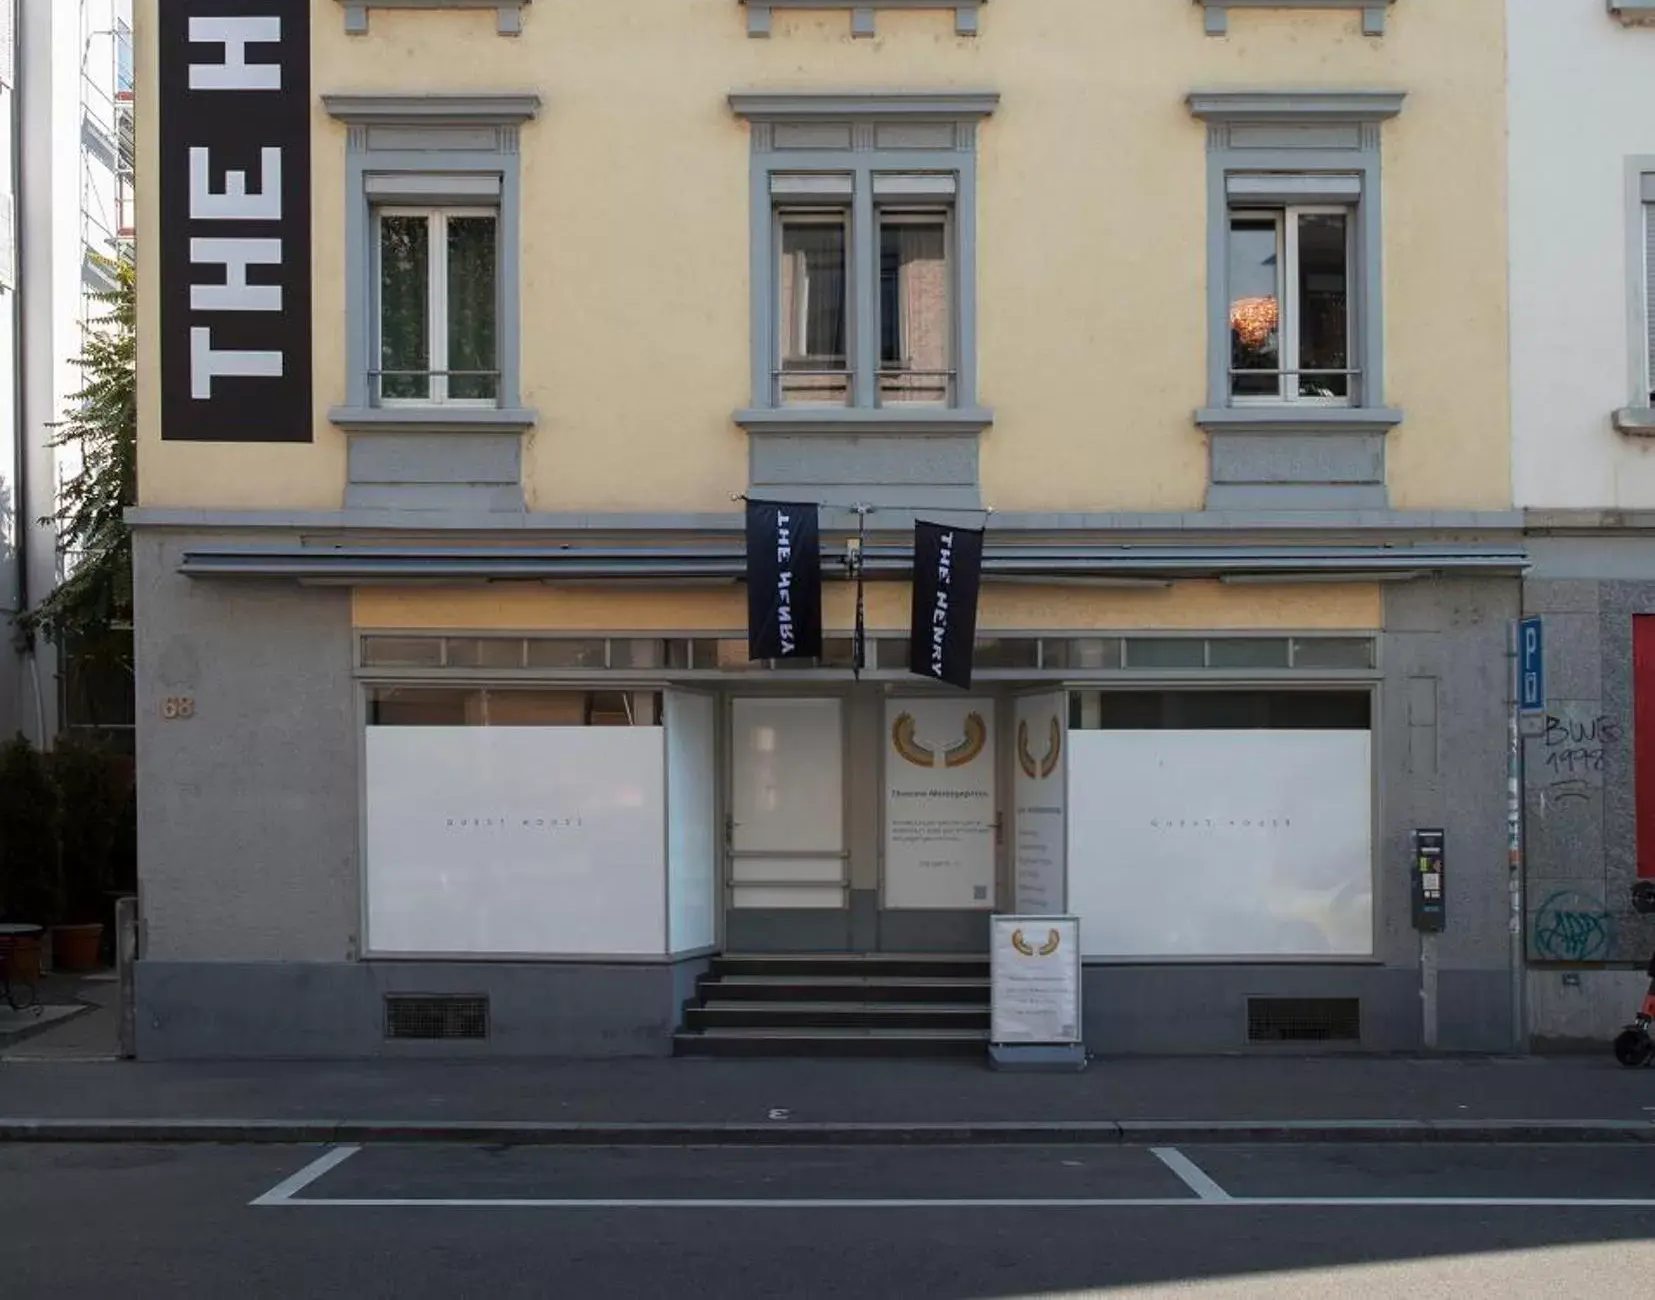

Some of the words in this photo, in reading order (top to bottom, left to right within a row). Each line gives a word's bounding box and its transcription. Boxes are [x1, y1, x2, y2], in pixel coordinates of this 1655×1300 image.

[189, 146, 283, 399] THE
[939, 531, 953, 584] THE
[930, 593, 948, 677] HENRY
[1525, 627, 1537, 669] P
